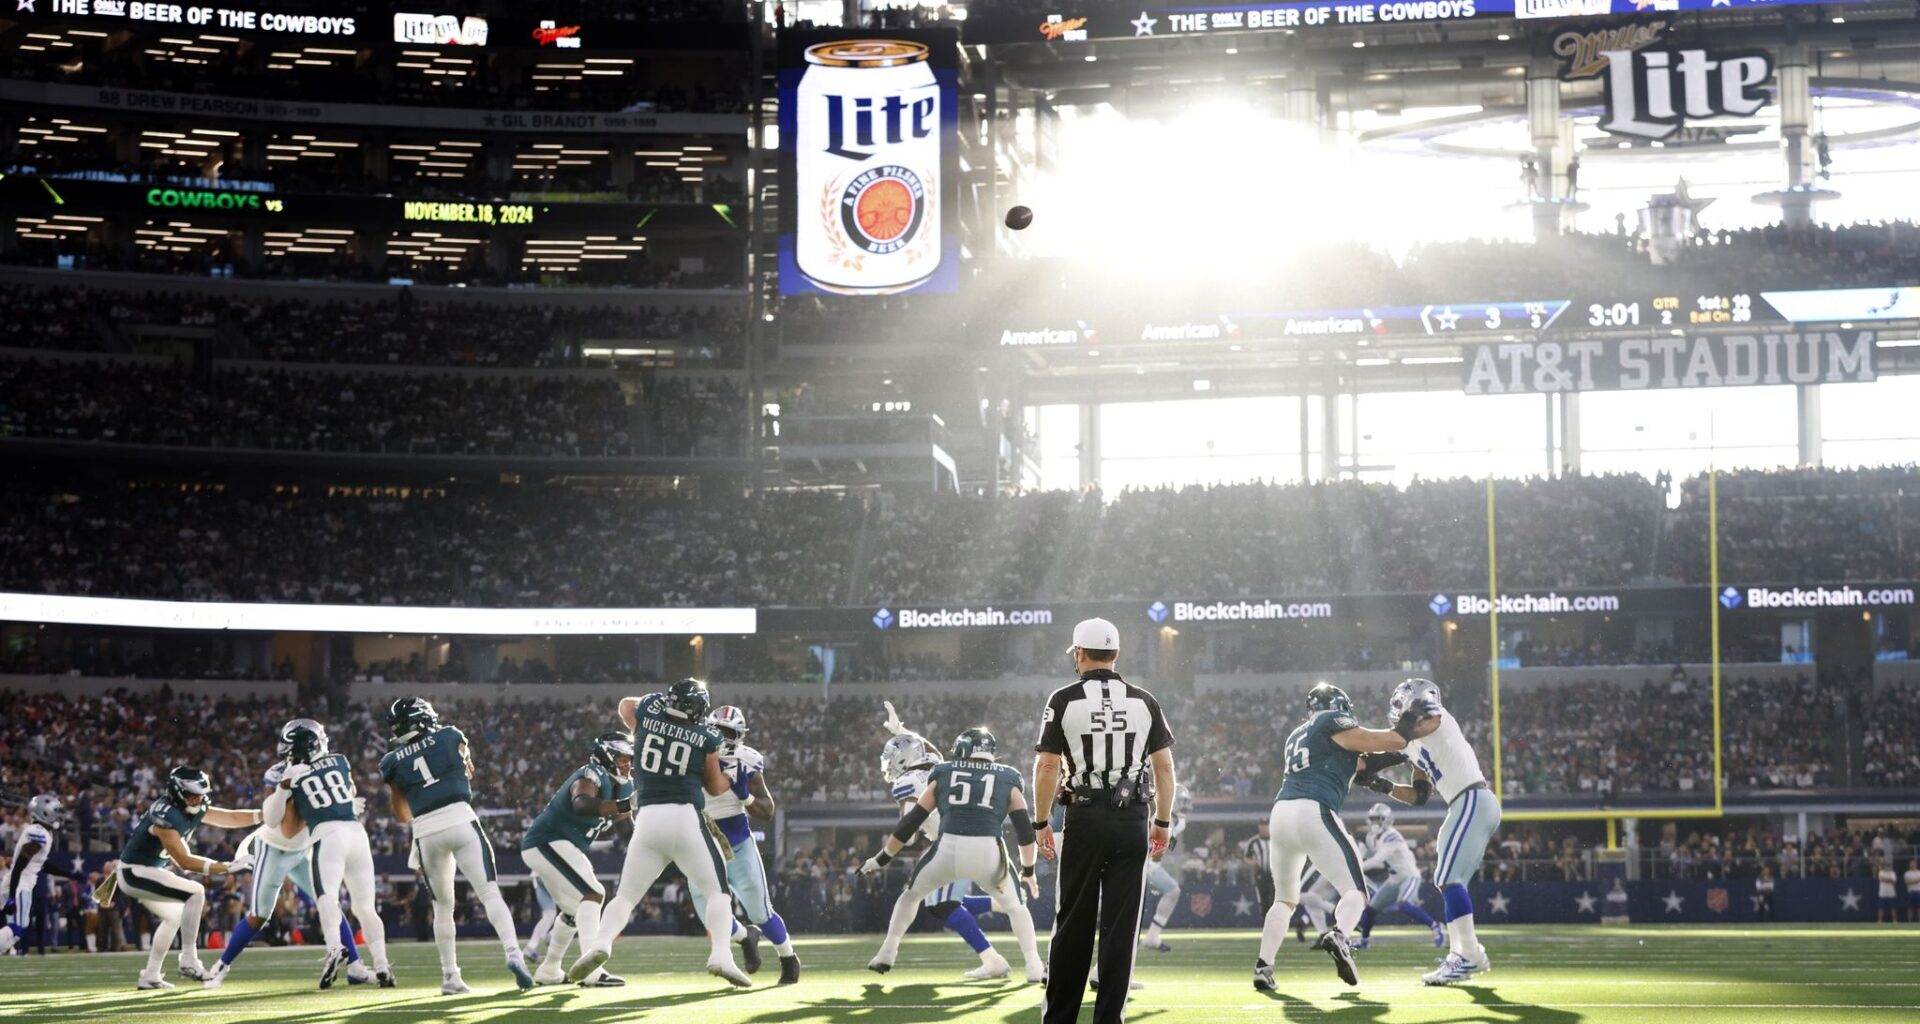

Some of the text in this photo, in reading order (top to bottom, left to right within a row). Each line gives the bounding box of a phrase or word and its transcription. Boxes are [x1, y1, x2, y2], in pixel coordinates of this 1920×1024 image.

[52, 0, 356, 35] THE ONLY BEER OF THE COWBOYS
[1168, 0, 1476, 32] THE ONLY BEER OF THE COWBOYS
[1553, 20, 1667, 78] Miller
[98, 90, 120, 105] 88
[127, 92, 175, 109] DREW
[180, 97, 258, 115] PEARSON
[1599, 49, 1768, 138] Lite
[501, 114, 527, 128] GIL
[532, 114, 597, 128] BRANDT
[821, 94, 934, 161] Lite
[147, 188, 260, 208] COWBOYS
[843, 166, 923, 207] A FINE PILSNER
[500, 205, 533, 223] 2024
[867, 238, 906, 254] BEER
[1588, 302, 1640, 326] 3:01
[1653, 296, 1680, 310] QTR
[1284, 317, 1363, 335] American
[1485, 307, 1501, 329] 3
[1530, 314, 1541, 329] 3
[1661, 310, 1672, 325] 2
[1000, 328, 1077, 346] American
[1141, 322, 1219, 341] American
[1465, 331, 1876, 395] AT&T STADIUM
[1457, 593, 1619, 614] Blockchain.com
[1747, 586, 1914, 609] Blockchain.com
[899, 609, 1052, 628] Blockchain.com
[1174, 601, 1332, 621] Blockchain.com
[642, 717, 707, 748] DICKERSON
[1091, 711, 1127, 732] 55
[396, 735, 436, 761] HURTS
[640, 733, 692, 776] 69
[412, 755, 440, 788] 1
[301, 770, 353, 809] 88
[948, 771, 996, 809] 51
